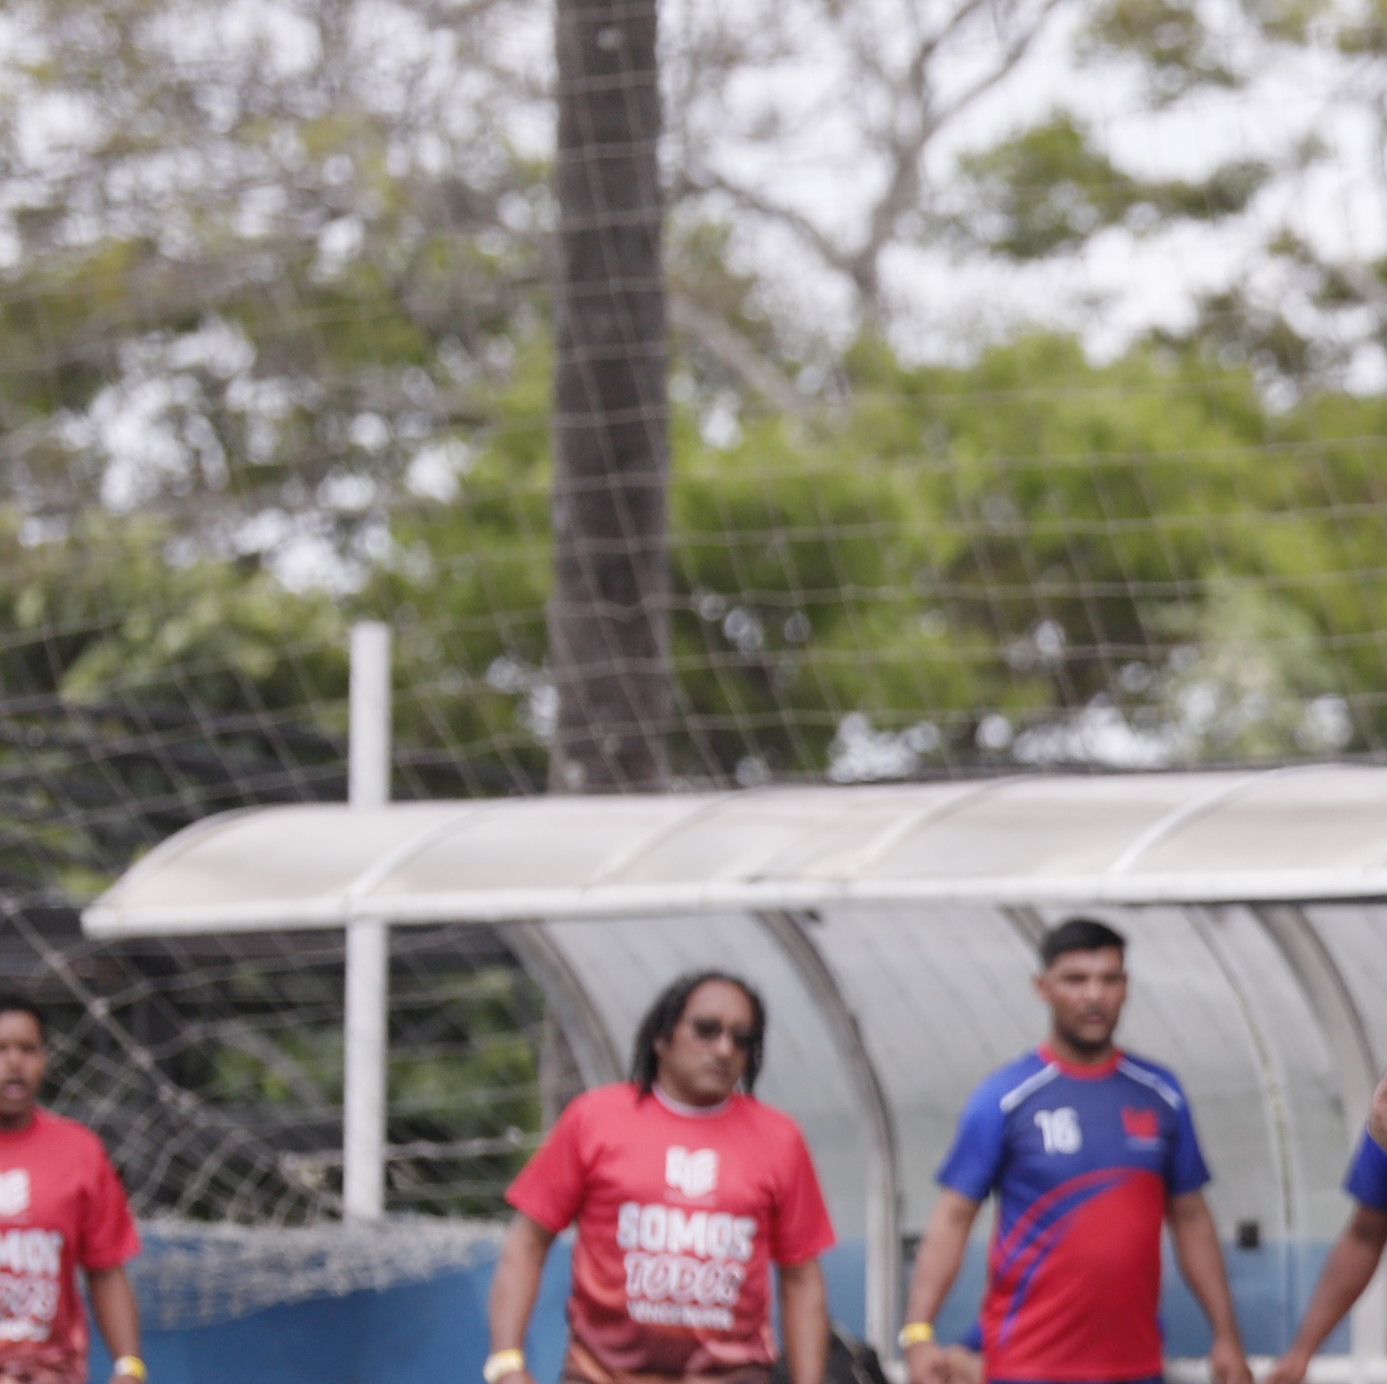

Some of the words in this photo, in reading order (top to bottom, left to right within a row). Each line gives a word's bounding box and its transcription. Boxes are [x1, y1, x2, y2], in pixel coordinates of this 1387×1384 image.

[1033, 1106, 1083, 1155] 16
[616, 1201, 758, 1263] SOMOS
[623, 1250, 746, 1307] TODOS
